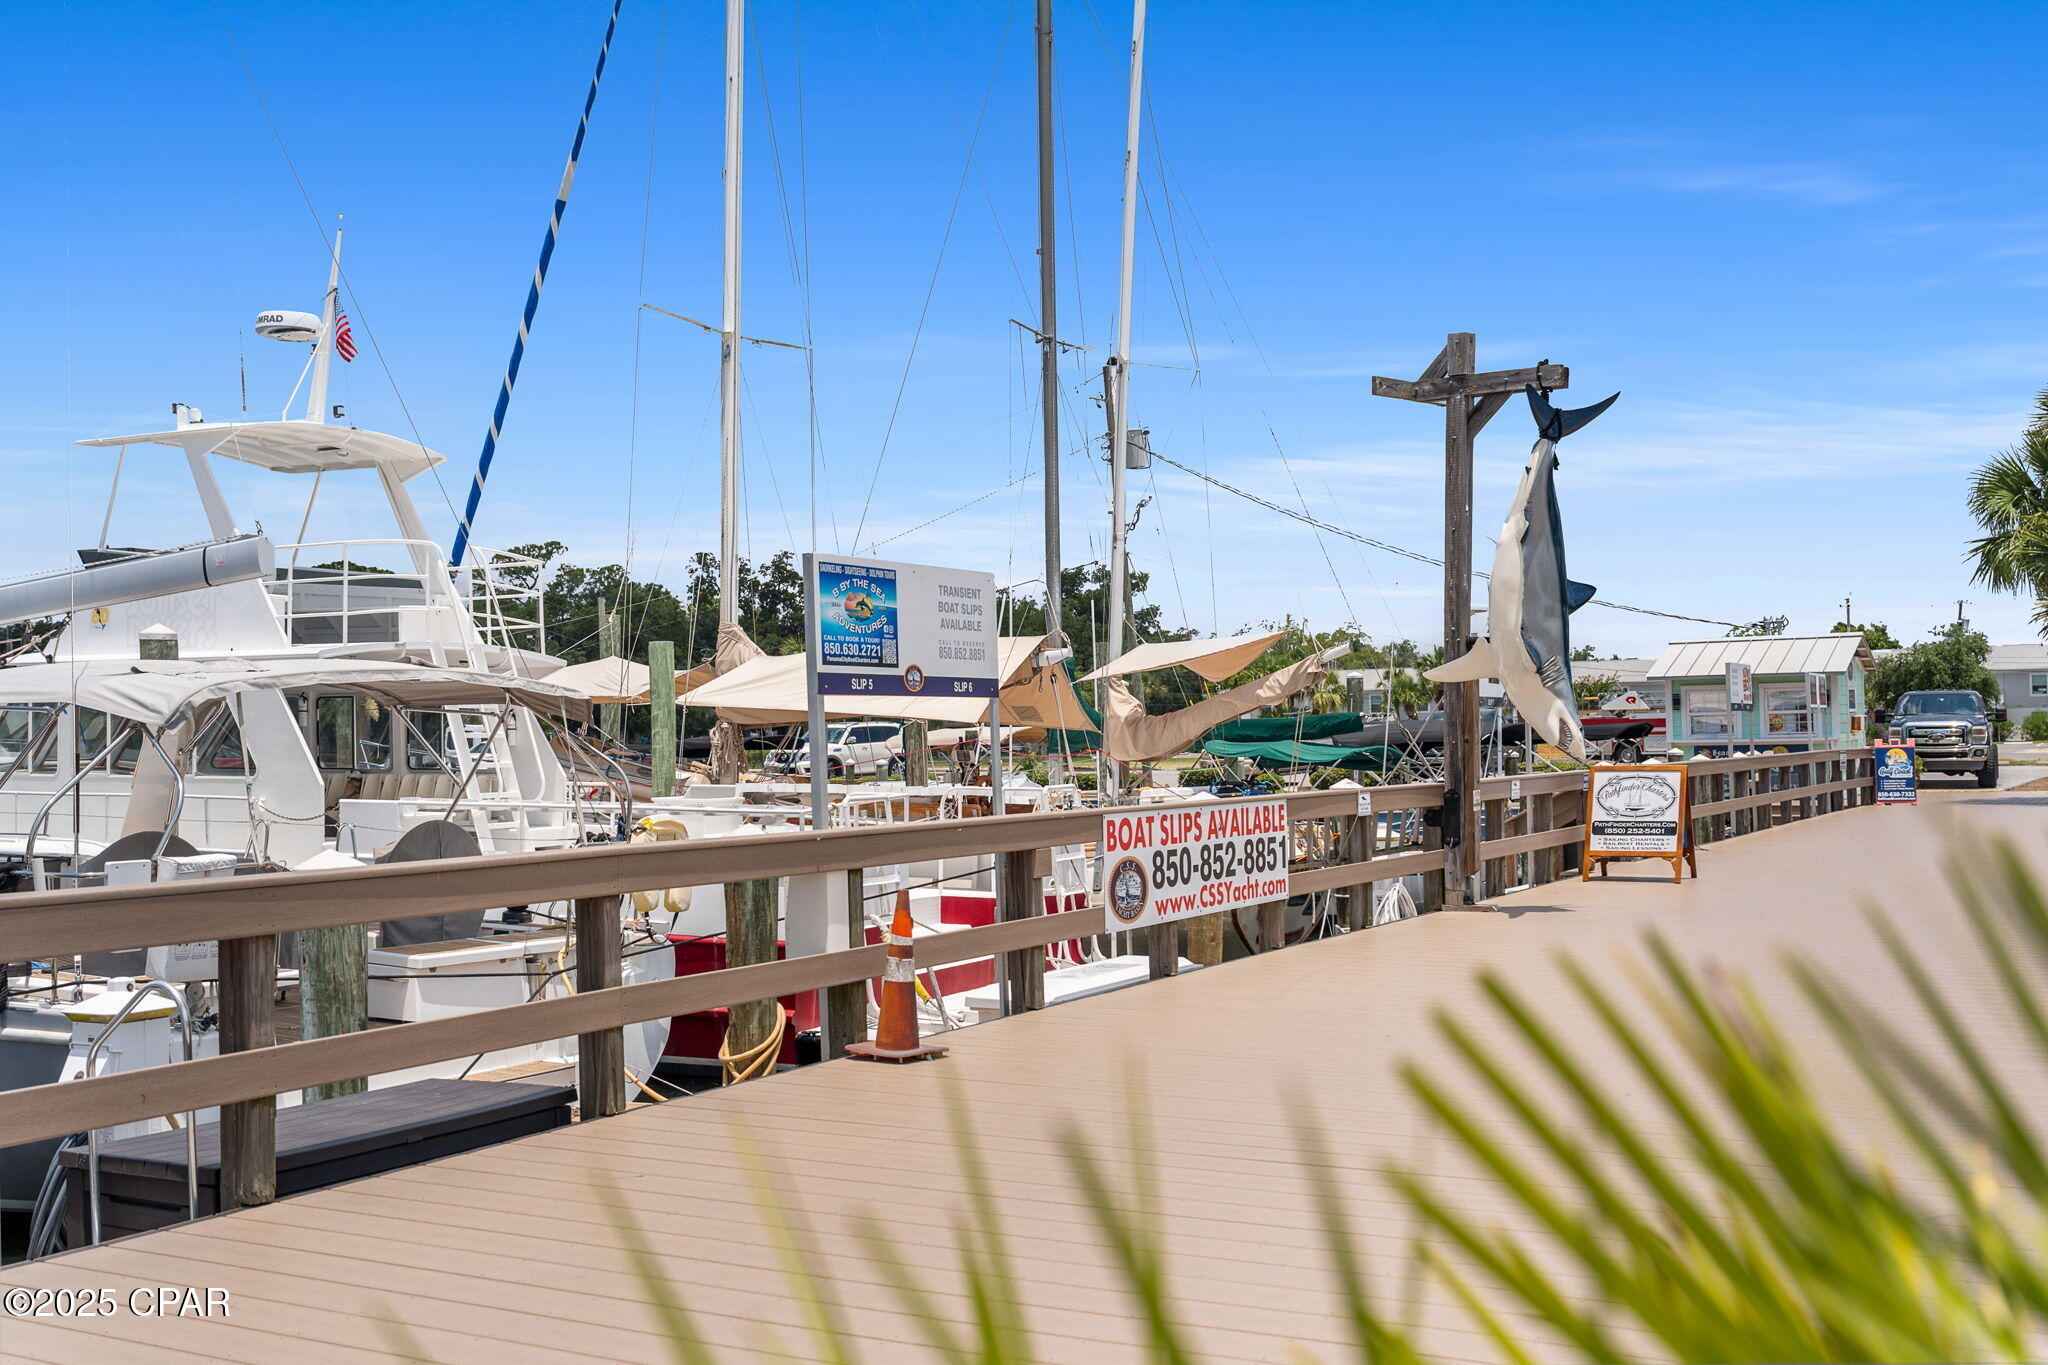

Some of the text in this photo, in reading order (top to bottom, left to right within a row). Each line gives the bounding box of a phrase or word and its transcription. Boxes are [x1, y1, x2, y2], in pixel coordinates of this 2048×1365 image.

[884, 571, 895, 579] TOURS
[832, 578, 887, 604] B BY THE SEA
[938, 585, 982, 599] TRANSIENT
[938, 601, 983, 616] BOAT SLIPS
[832, 612, 887, 634] ADVENTURES
[940, 618, 982, 632] AVAILABLE
[824, 642, 880, 656] 850.630.2721
[939, 646, 986, 661] 850.852.8851
[852, 678, 873, 690] SLIP 5
[954, 682, 973, 692] SLIP 6
[1602, 783, 1640, 802] Pathfinder
[1106, 804, 1285, 852] BOAT SLIPS AVAILABLE
[1152, 835, 1286, 889] 850-852-8851
[1155, 876, 1286, 916] www.CSSYacht.com
